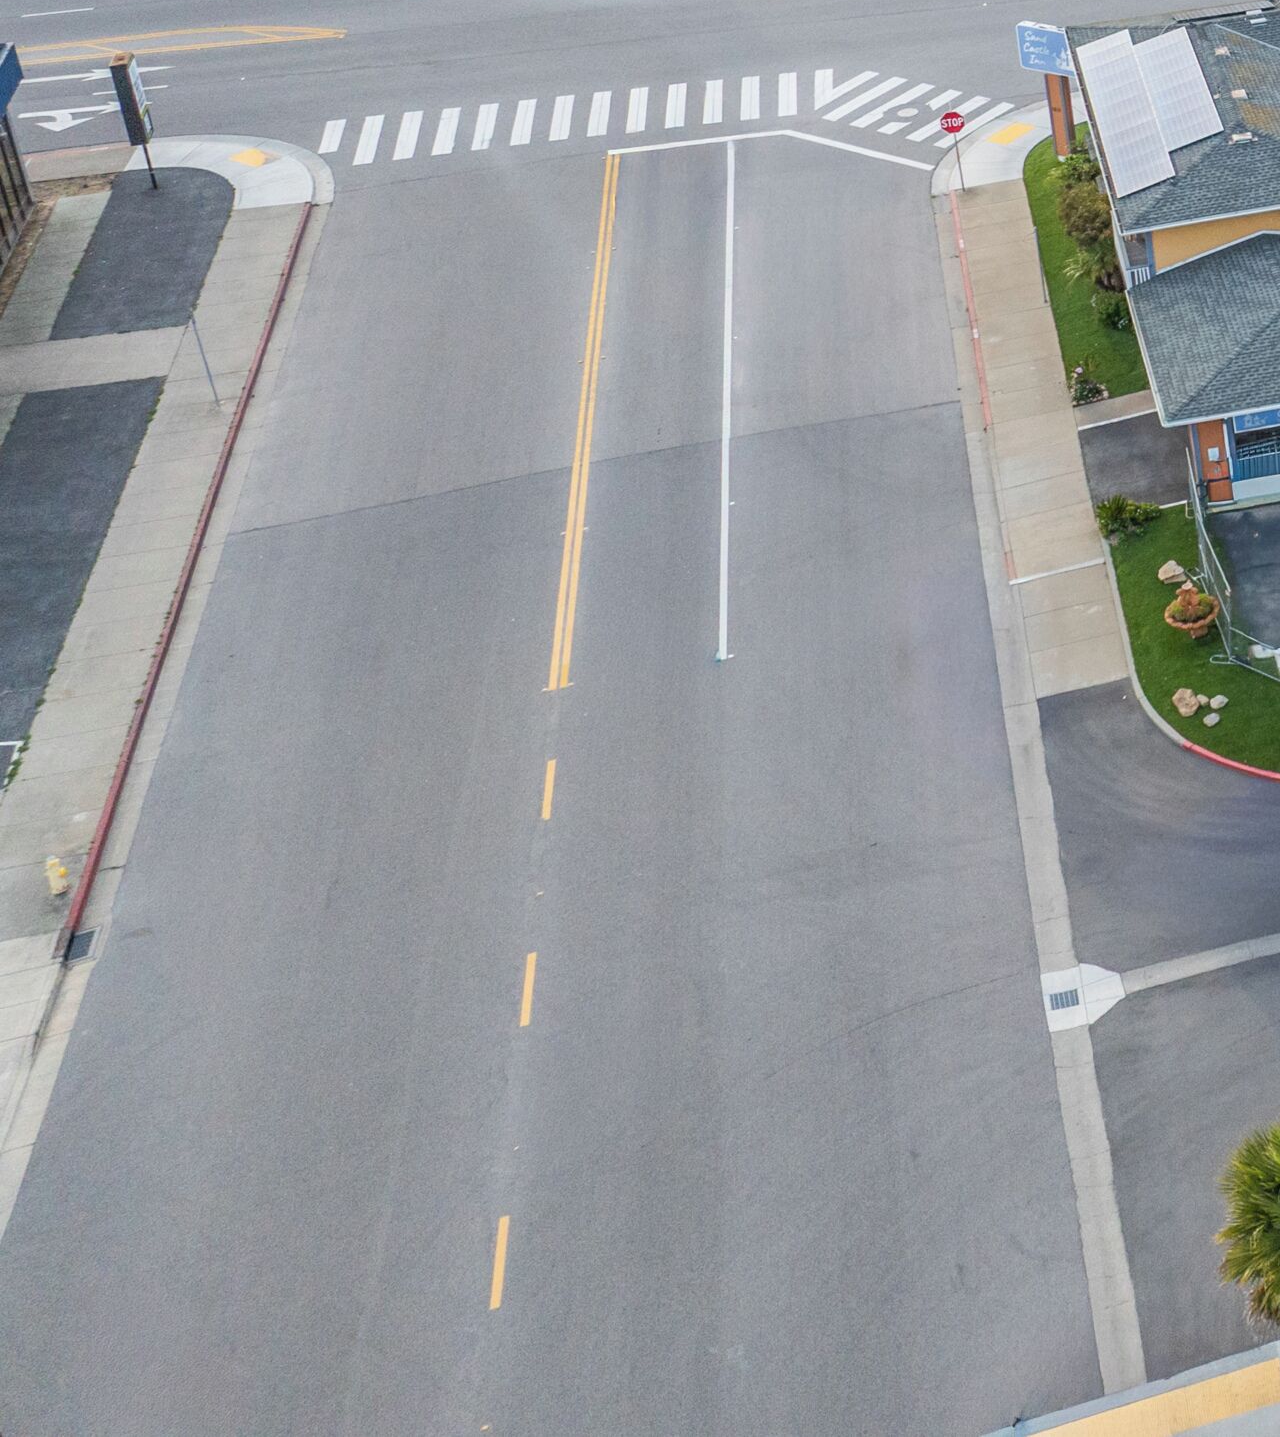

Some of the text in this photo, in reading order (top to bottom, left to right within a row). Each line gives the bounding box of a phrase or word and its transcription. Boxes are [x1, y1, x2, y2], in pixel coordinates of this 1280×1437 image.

[1024, 30, 1047, 44] Sand
[1023, 43, 1050, 55] Castle
[1029, 54, 1046, 66] Inn
[941, 117, 963, 129] STOP
